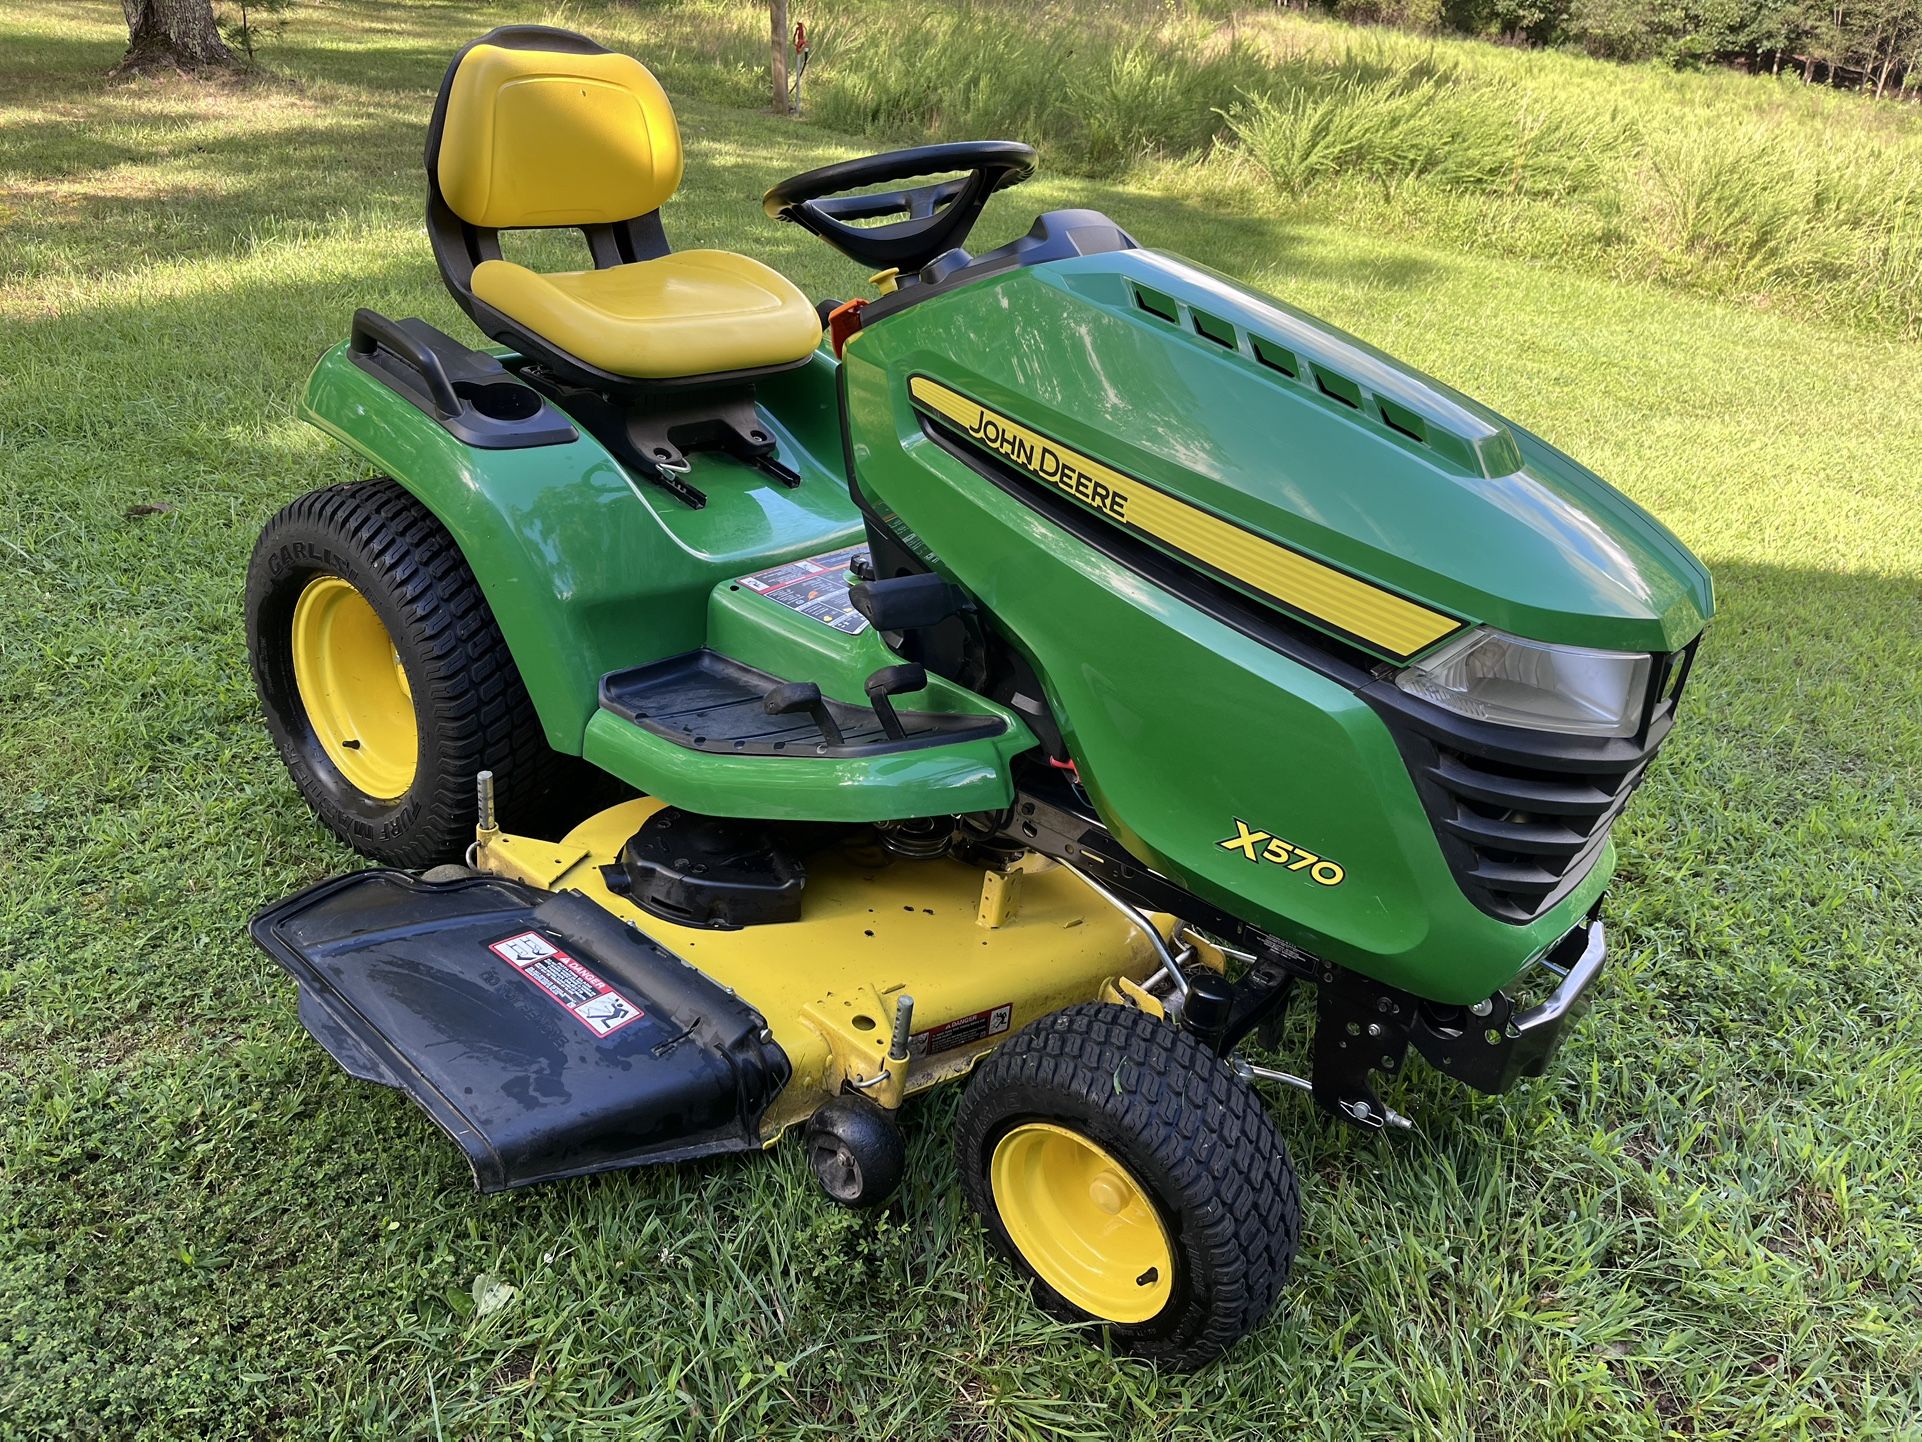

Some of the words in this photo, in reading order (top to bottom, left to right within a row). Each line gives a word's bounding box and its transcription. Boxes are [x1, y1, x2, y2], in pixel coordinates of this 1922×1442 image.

[968, 410, 1035, 467] JOHN
[1040, 448, 1129, 519] DEERE
[380, 795, 422, 841] TURF
[1216, 817, 1346, 887] X570
[567, 961, 606, 989] DANGER
[950, 1014, 978, 1028] DANGER
